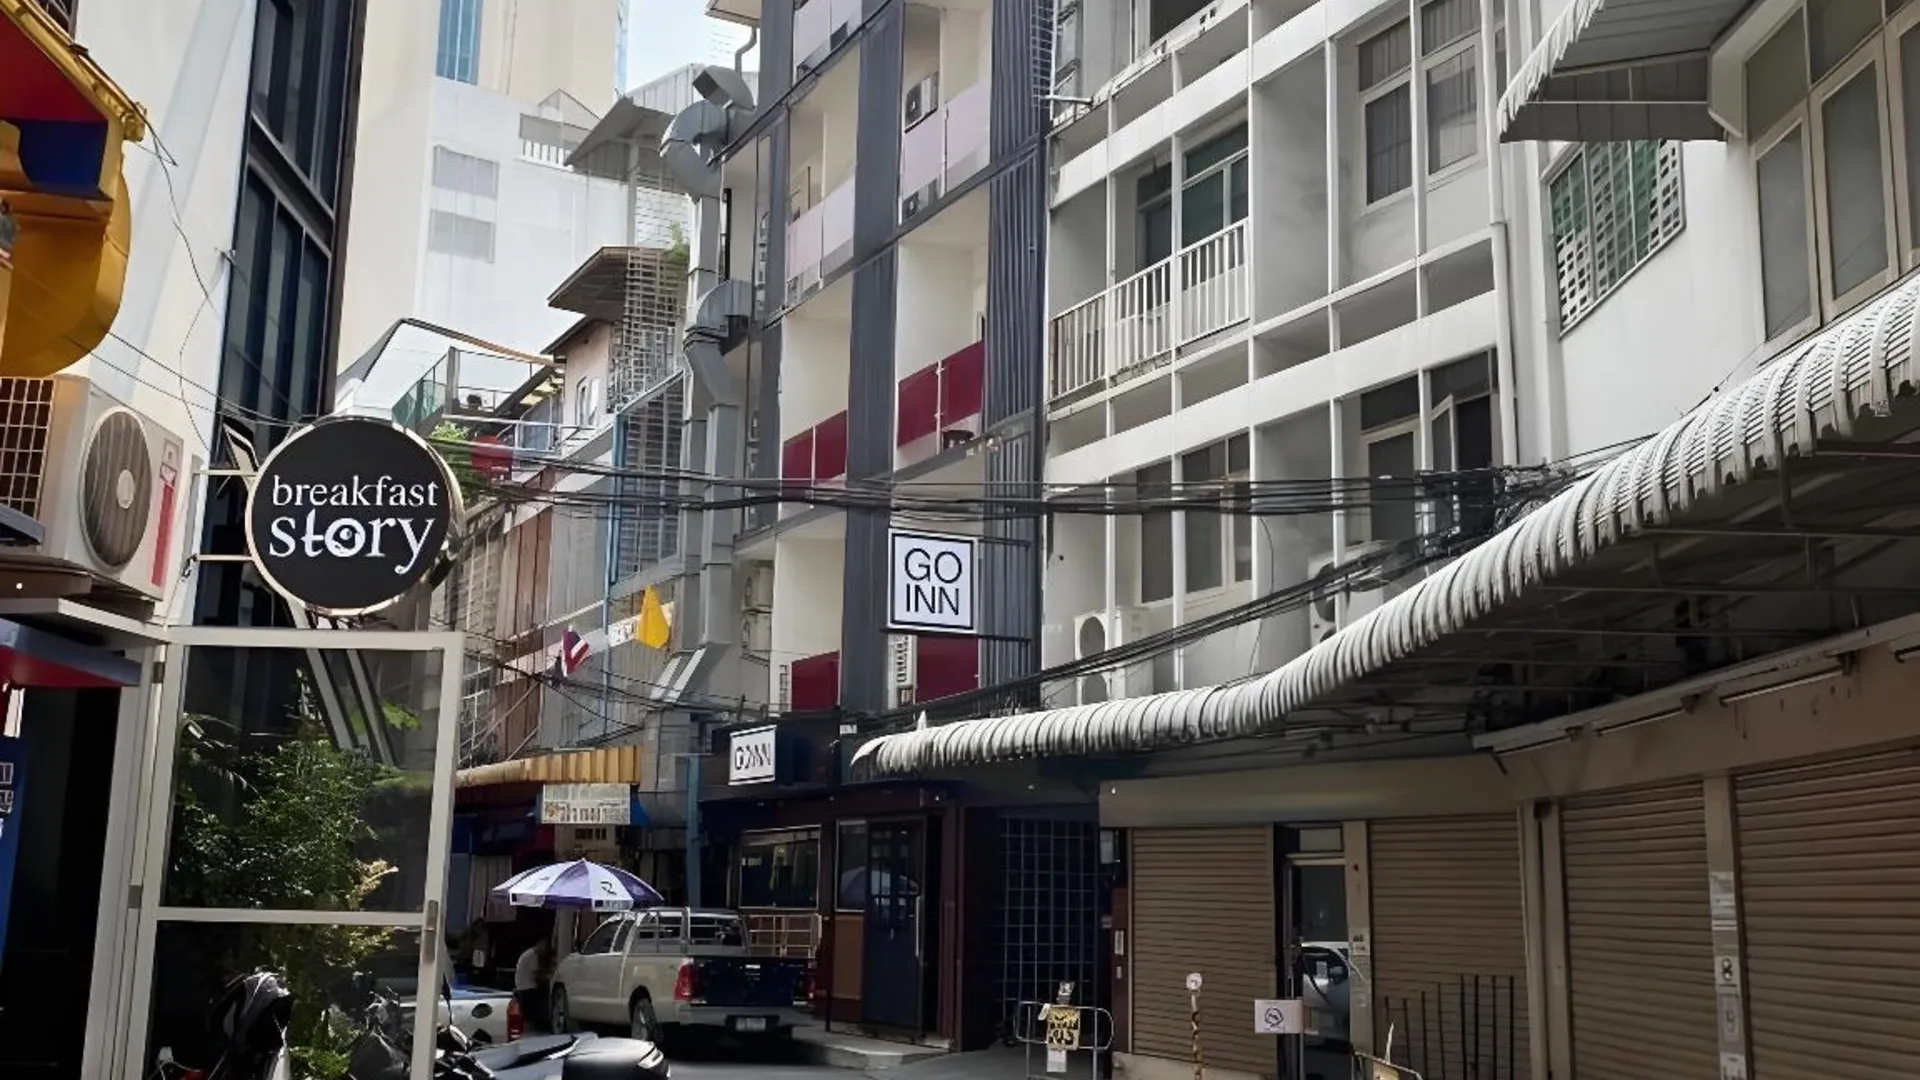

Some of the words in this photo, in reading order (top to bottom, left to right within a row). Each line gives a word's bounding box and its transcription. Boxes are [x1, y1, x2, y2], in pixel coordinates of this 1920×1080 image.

[272, 474, 439, 507] breakfast
[269, 508, 436, 575] story
[904, 547, 963, 584] GO
[906, 583, 960, 616] INN
